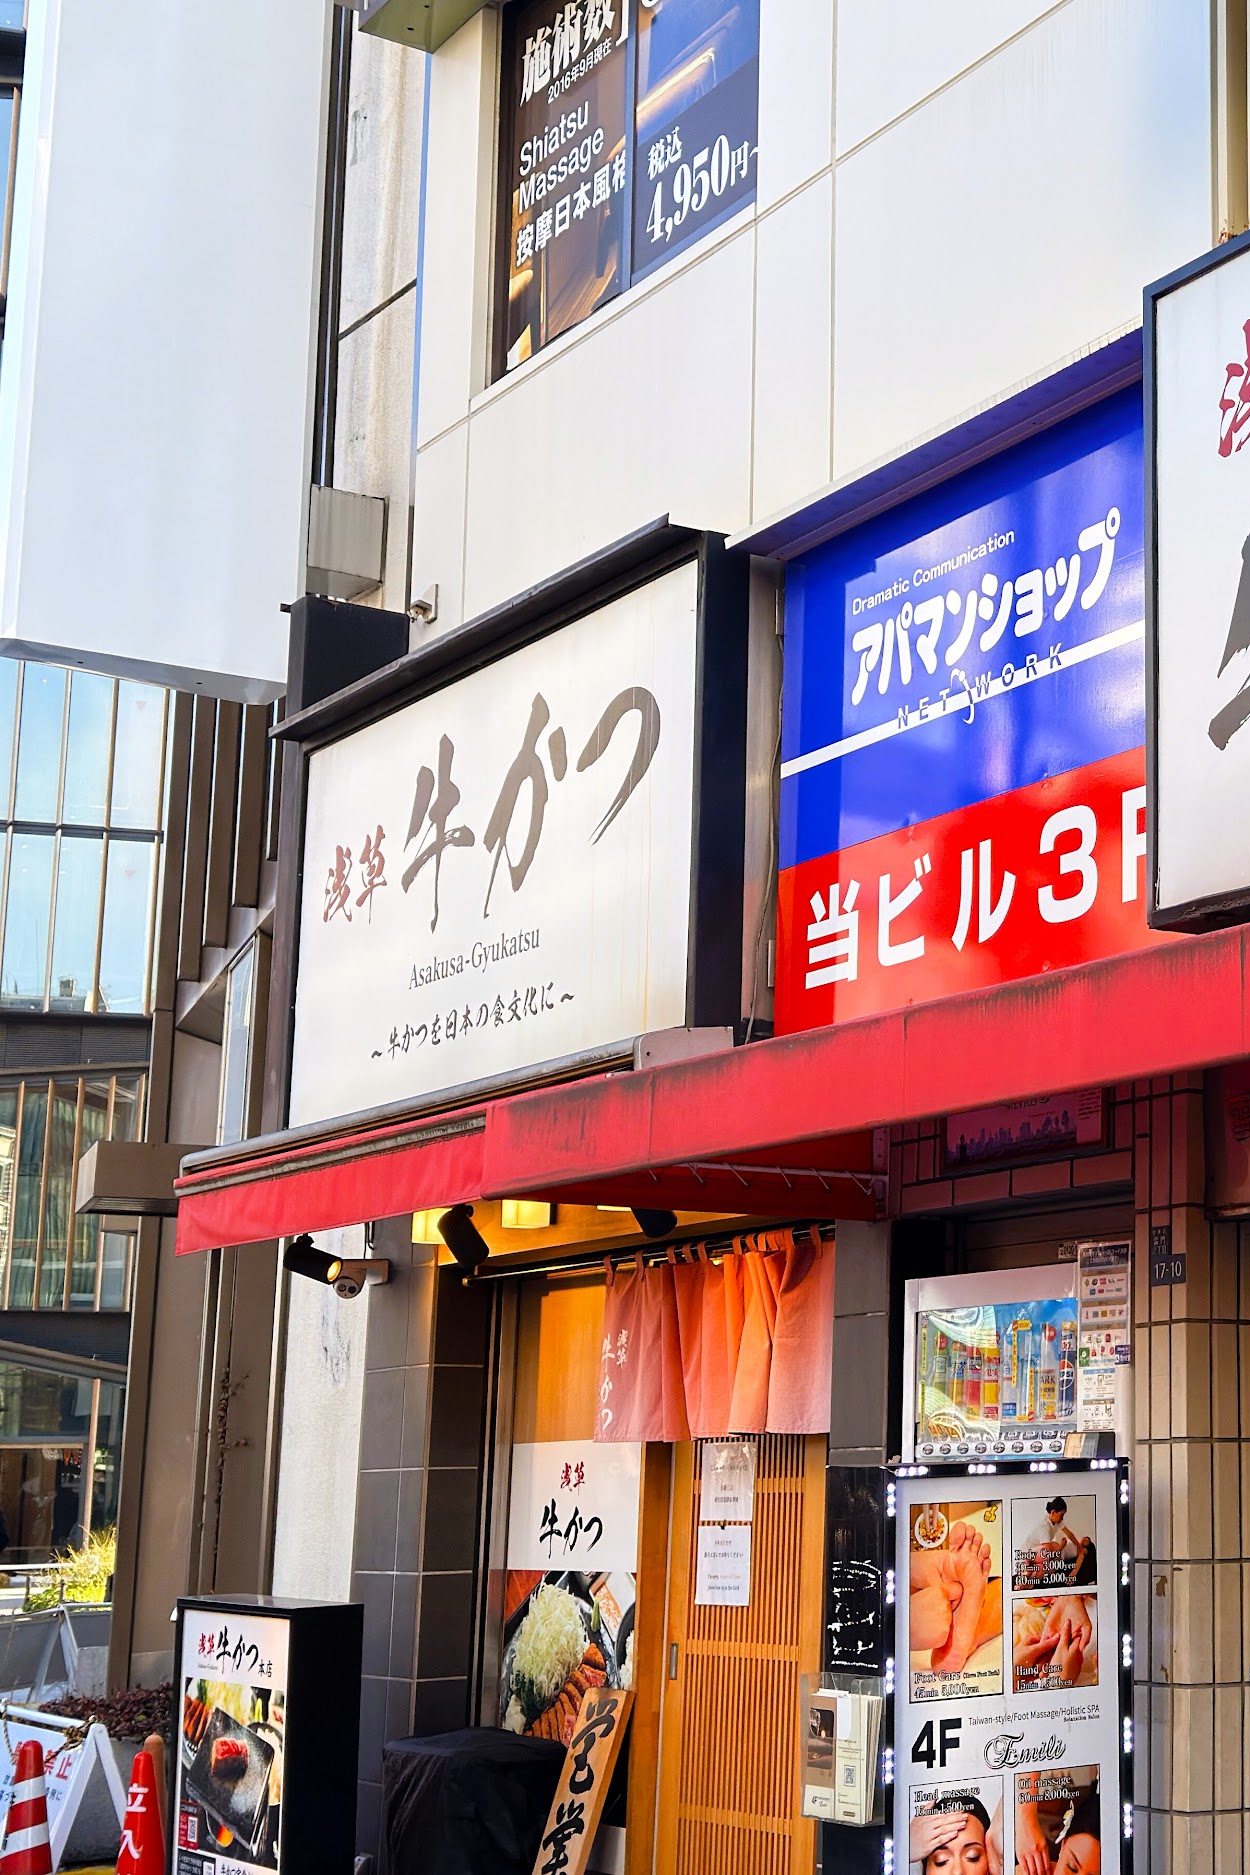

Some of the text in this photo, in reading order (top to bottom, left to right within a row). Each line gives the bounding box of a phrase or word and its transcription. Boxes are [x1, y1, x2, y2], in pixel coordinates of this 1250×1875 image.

[548, 38, 611, 104] 2016年9月現在
[519, 101, 589, 177] Shiatsu
[647, 126, 682, 180] 税込
[518, 127, 604, 215] Massage
[852, 528, 1015, 616] Dramatic Communication
[851, 507, 1121, 706] アパマンショップ
[322, 686, 661, 934] 浅草 牛かつ
[409, 927, 541, 990] Asakusa-Gyukatsu
[1154, 1261, 1182, 1279] 17-10
[616, 1329, 629, 1369] 浅草
[600, 1333, 615, 1431] 牛かつ
[559, 1462, 585, 1495] 浅草
[539, 1499, 602, 1558] 牛かつ
[1014, 1548, 1060, 1561] Body Care
[216, 1625, 259, 1674] 牛かつ
[1016, 1662, 1062, 1676] Hand Care
[914, 1672, 937, 1685] Foot
[938, 1670, 960, 1682] Care
[1087, 1704, 1100, 1713] SPA
[911, 1717, 962, 1769] 4F
[914, 1785, 981, 1803] Head massage
[1034, 1776, 1071, 1787] massage
[118, 1783, 149, 1875] 立入
